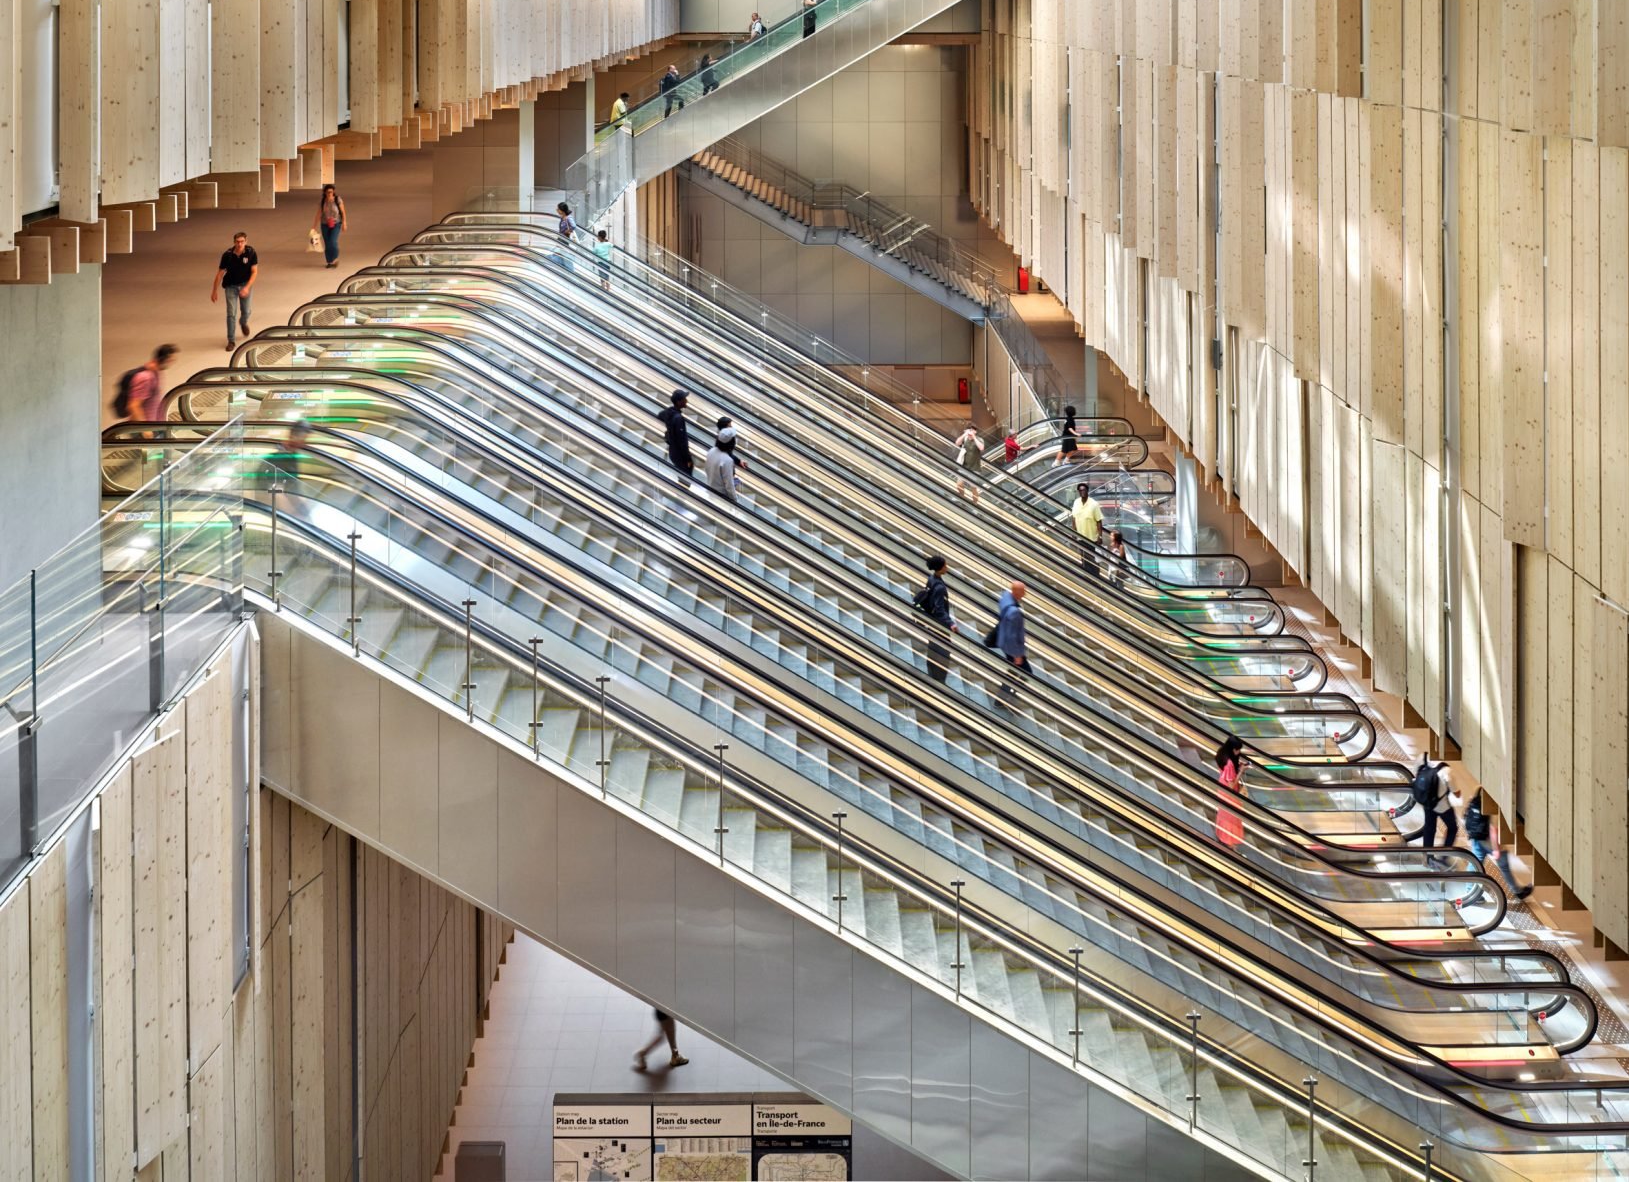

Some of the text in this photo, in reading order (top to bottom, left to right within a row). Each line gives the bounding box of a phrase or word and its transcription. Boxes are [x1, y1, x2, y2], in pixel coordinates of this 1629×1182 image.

[756, 1111, 798, 1120] Transport
[556, 1117, 629, 1125] Plan de la station
[656, 1117, 675, 1125] Plan
[676, 1117, 688, 1125] du
[769, 1119, 826, 1128] Île-de-France
